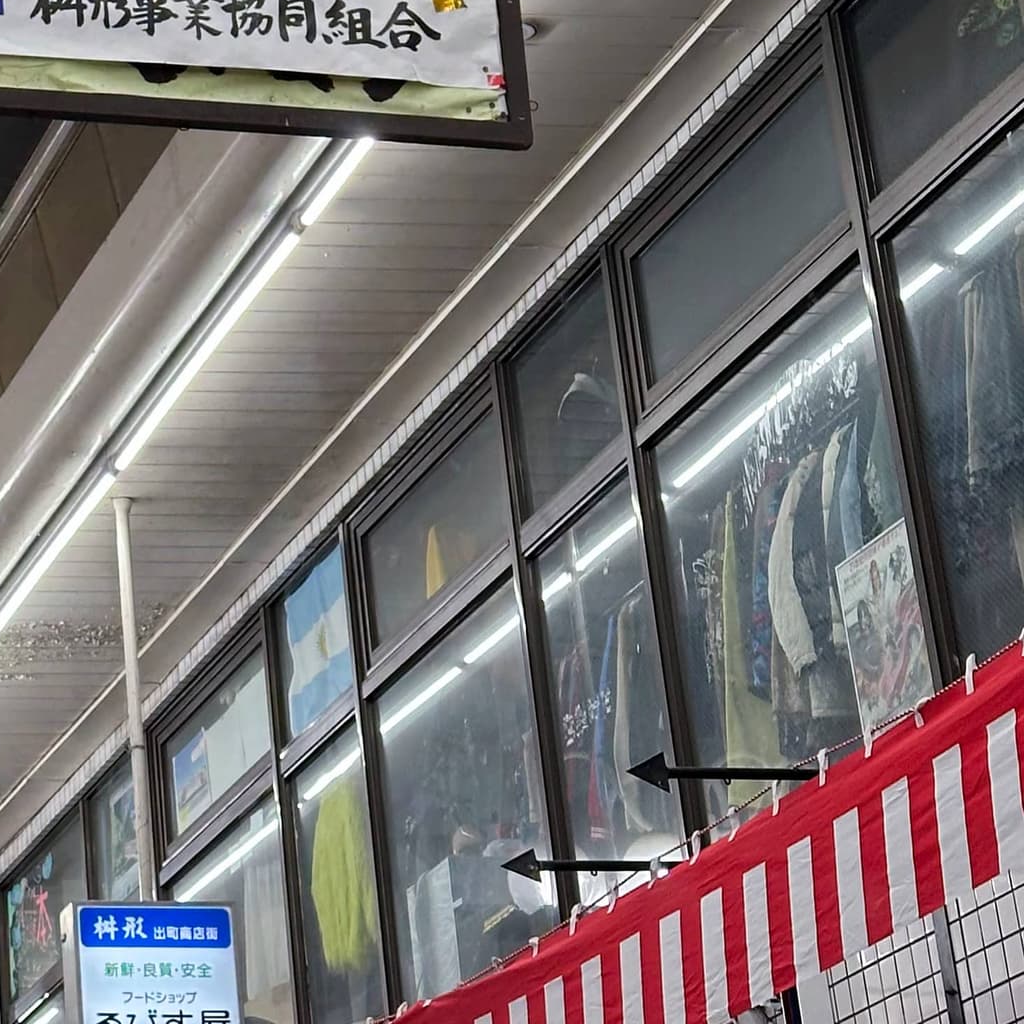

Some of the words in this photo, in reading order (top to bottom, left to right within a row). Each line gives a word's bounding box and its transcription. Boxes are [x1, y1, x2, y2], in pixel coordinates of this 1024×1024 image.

[121, 991, 198, 1004] フードショップ
